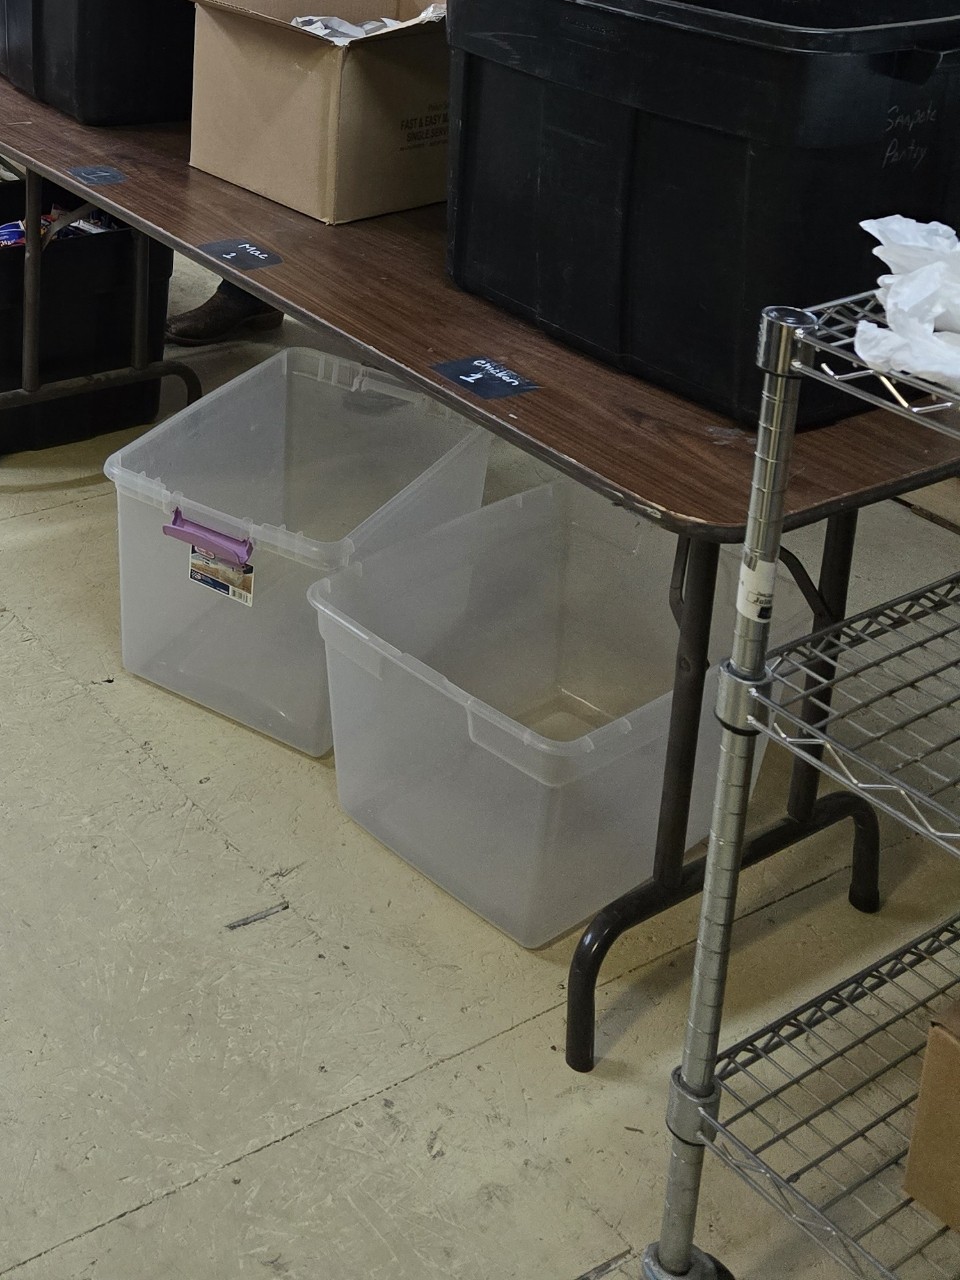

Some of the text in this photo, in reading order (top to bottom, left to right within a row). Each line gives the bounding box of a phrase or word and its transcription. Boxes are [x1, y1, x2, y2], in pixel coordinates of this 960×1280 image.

[401, 119, 417, 130] FAST
[424, 114, 441, 127] EASY
[406, 127, 449, 142] SINGLE SERV
[238, 243, 268, 260] Mac
[459, 372, 483, 383] 1
